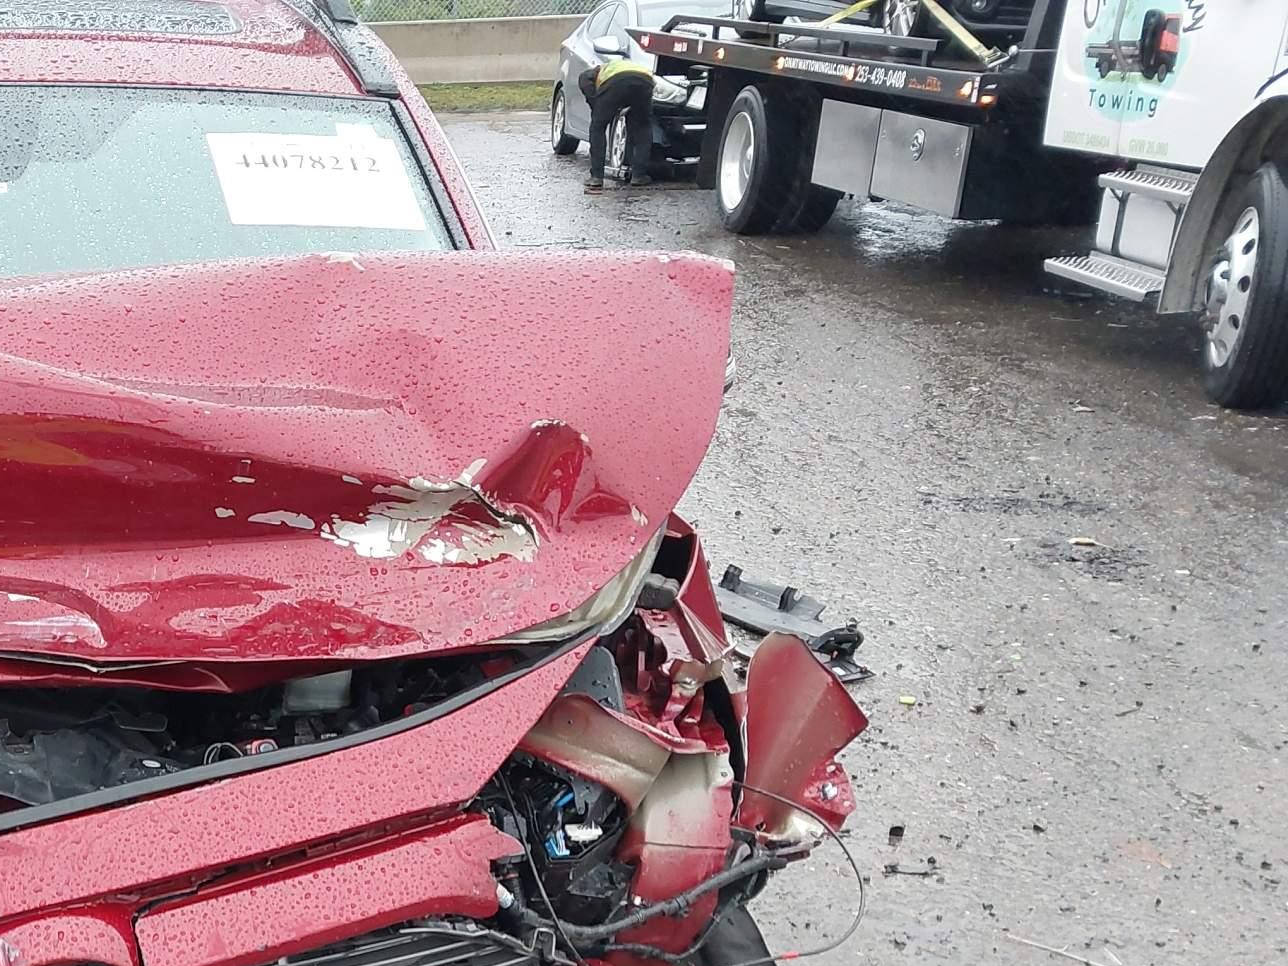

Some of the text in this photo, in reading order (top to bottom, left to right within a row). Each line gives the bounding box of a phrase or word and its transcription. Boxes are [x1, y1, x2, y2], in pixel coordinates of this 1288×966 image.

[855, 66, 907, 88] 253-439-0408
[1089, 88, 1158, 118] Towing
[235, 153, 381, 173] 44078212
